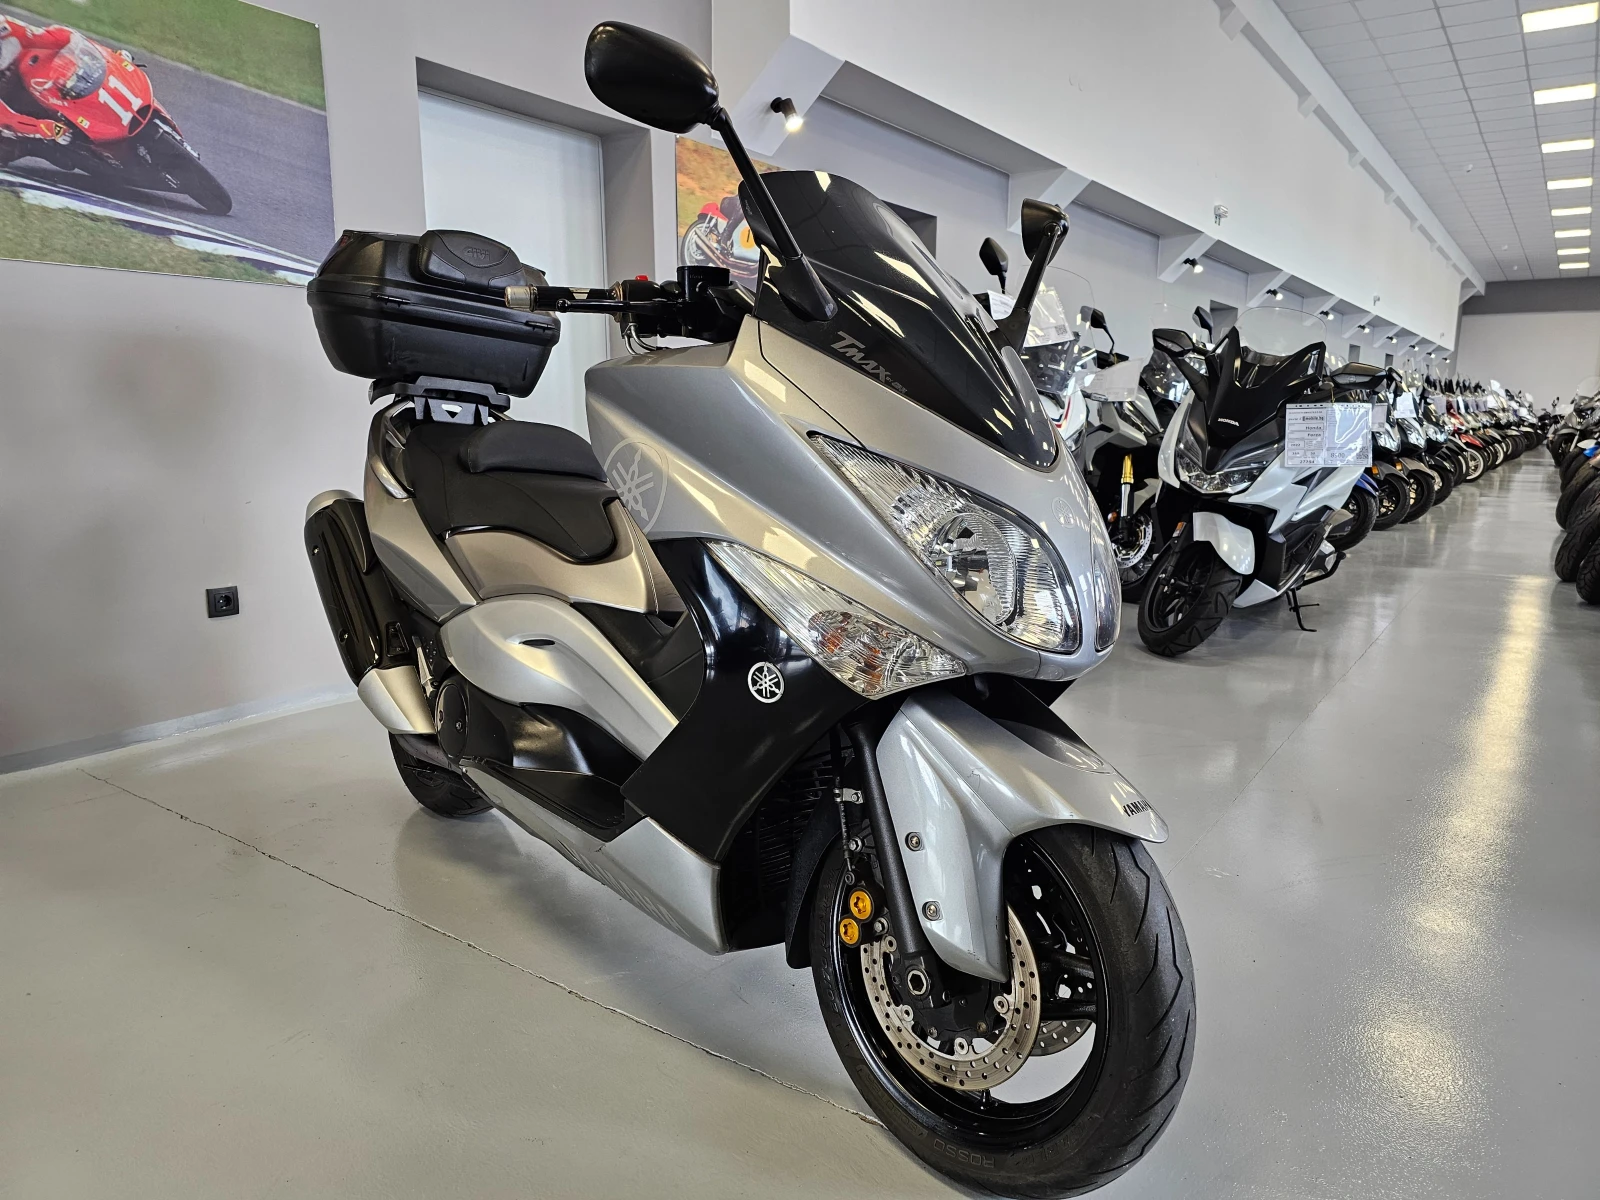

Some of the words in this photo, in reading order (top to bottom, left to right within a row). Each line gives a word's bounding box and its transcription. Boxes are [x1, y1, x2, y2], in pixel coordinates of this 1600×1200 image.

[98, 74, 143, 127] 11
[1217, 417, 1240, 427] HONDA
[933, 1138, 995, 1169] ROSSO
